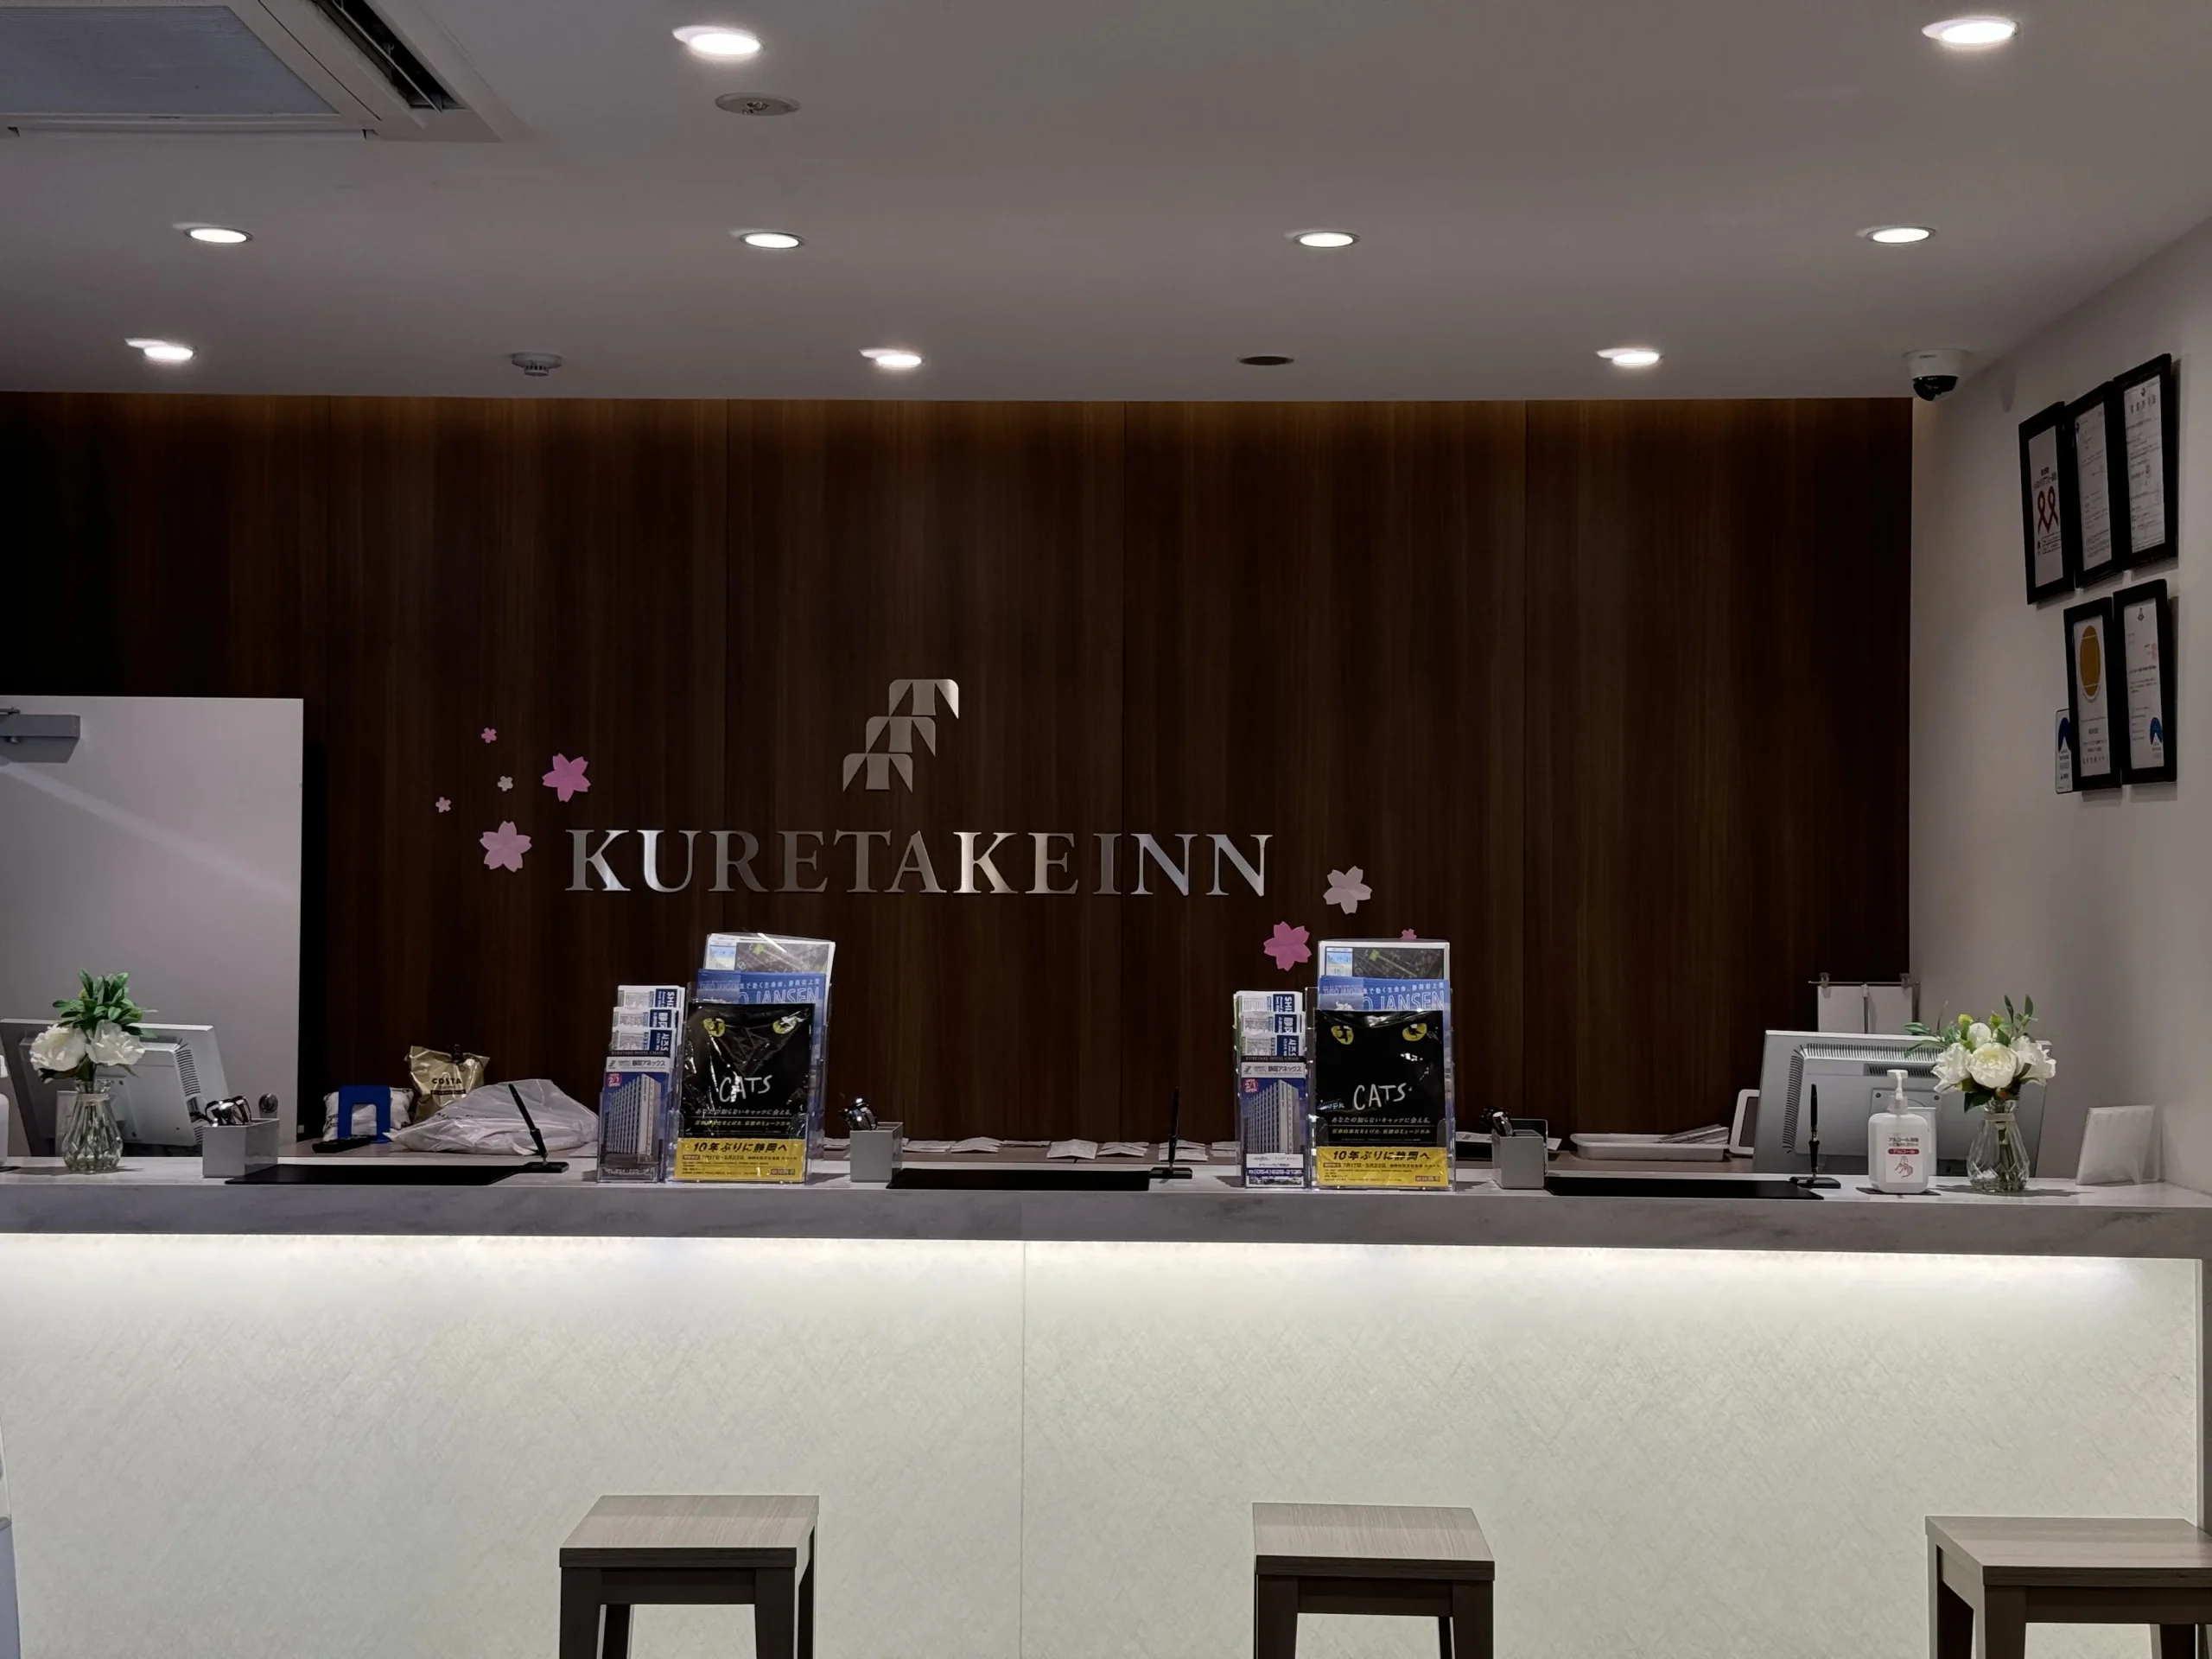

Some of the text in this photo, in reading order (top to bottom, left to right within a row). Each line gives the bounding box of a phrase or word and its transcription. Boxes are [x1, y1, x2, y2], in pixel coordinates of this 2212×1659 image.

[719, 1074, 773, 1103] CATS
[1353, 1083, 1408, 1111] CATS
[693, 1141, 788, 1154] 10年ぶりに静岡へ
[1332, 1150, 1431, 1161] 10年ぶりに静岡へ
